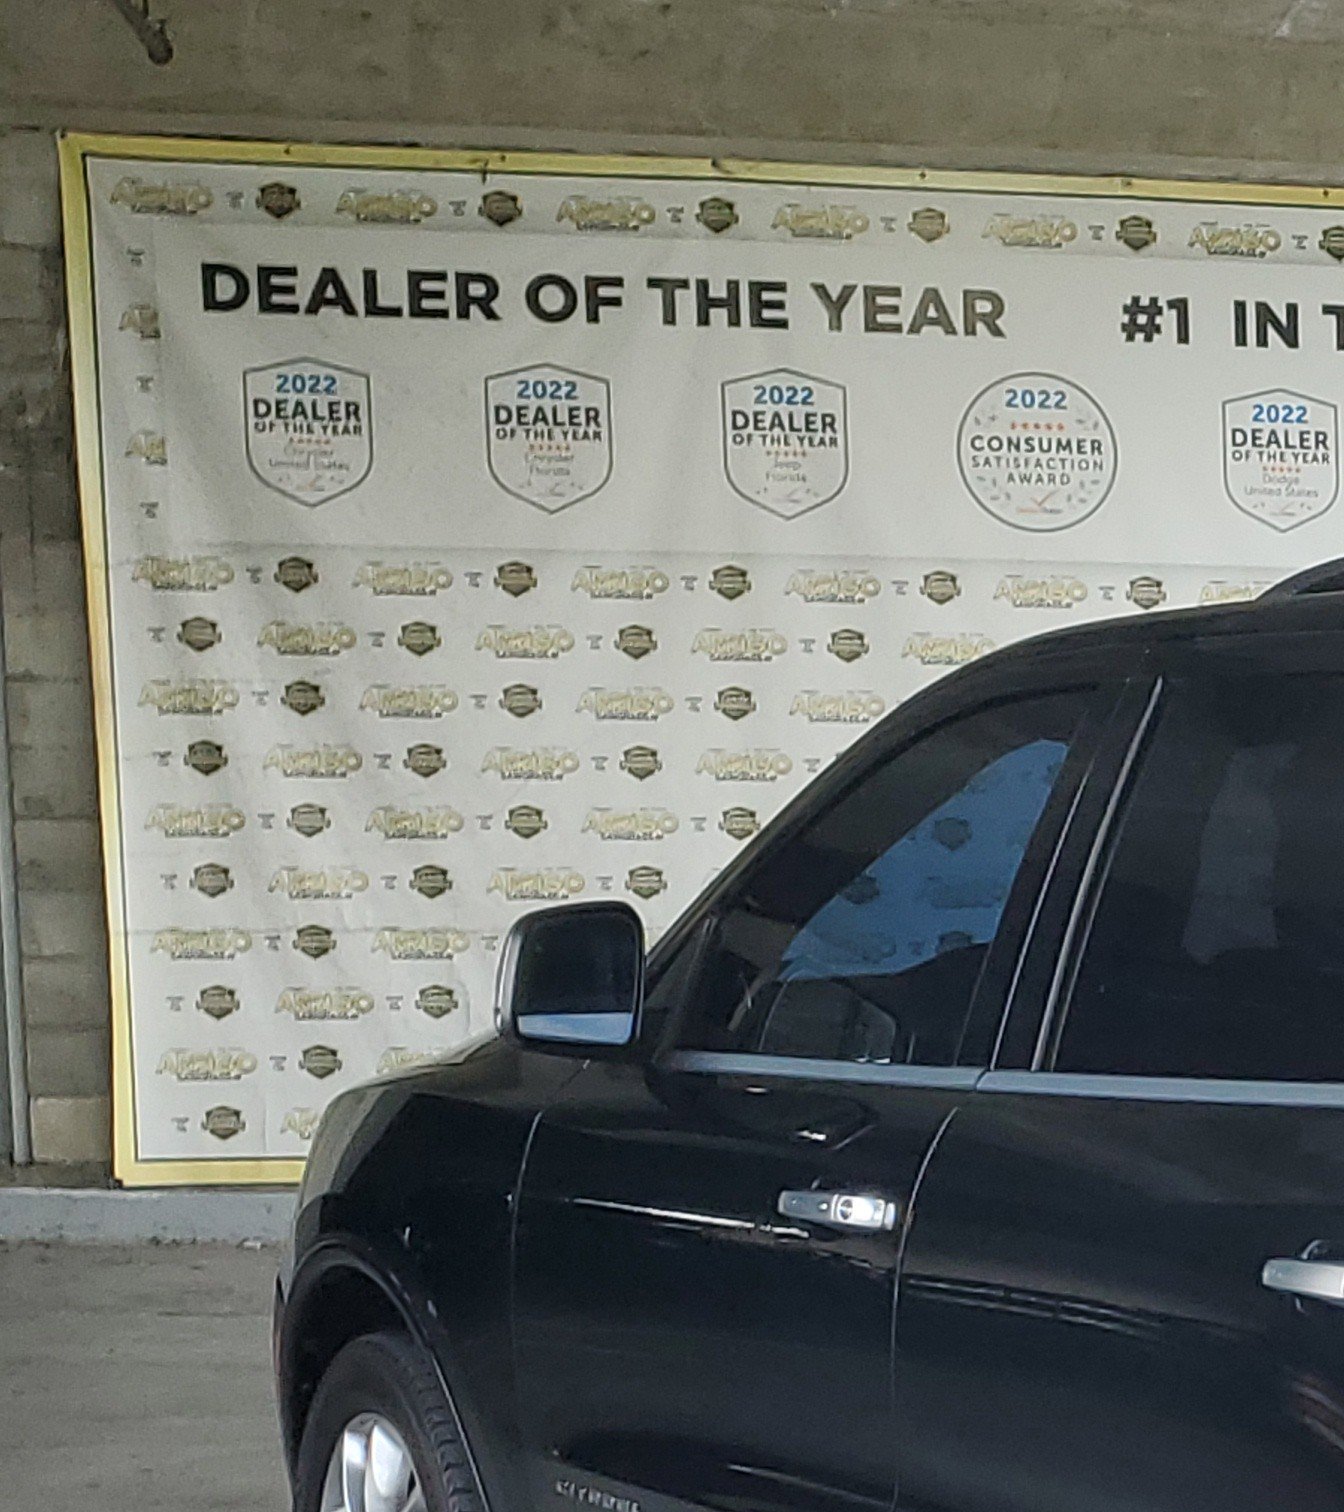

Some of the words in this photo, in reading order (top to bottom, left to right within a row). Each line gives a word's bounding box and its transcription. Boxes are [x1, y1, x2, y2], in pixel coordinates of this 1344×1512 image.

[201, 262, 501, 322] DEALER
[524, 273, 625, 324] OF
[647, 277, 789, 331] THE
[811, 282, 1007, 340] YEAR
[1120, 295, 1191, 346] #1
[1234, 299, 1300, 350] IN
[276, 374, 337, 395] 2022
[517, 380, 579, 400] 2022
[753, 385, 815, 406] 2022
[1005, 388, 1068, 410] 2022
[253, 398, 361, 422] DEALER
[494, 404, 602, 428] DEALER
[1251, 404, 1309, 424] 2022
[731, 410, 837, 434] DEALER
[970, 435, 1103, 456] CONSUMER
[1231, 428, 1330, 450] DEALER
[971, 455, 1104, 472] SATISFACTION
[1231, 450, 1251, 462] OF
[1257, 450, 1287, 463] THE
[1291, 452, 1331, 465] YEAR
[1007, 473, 1071, 486] AWARD
